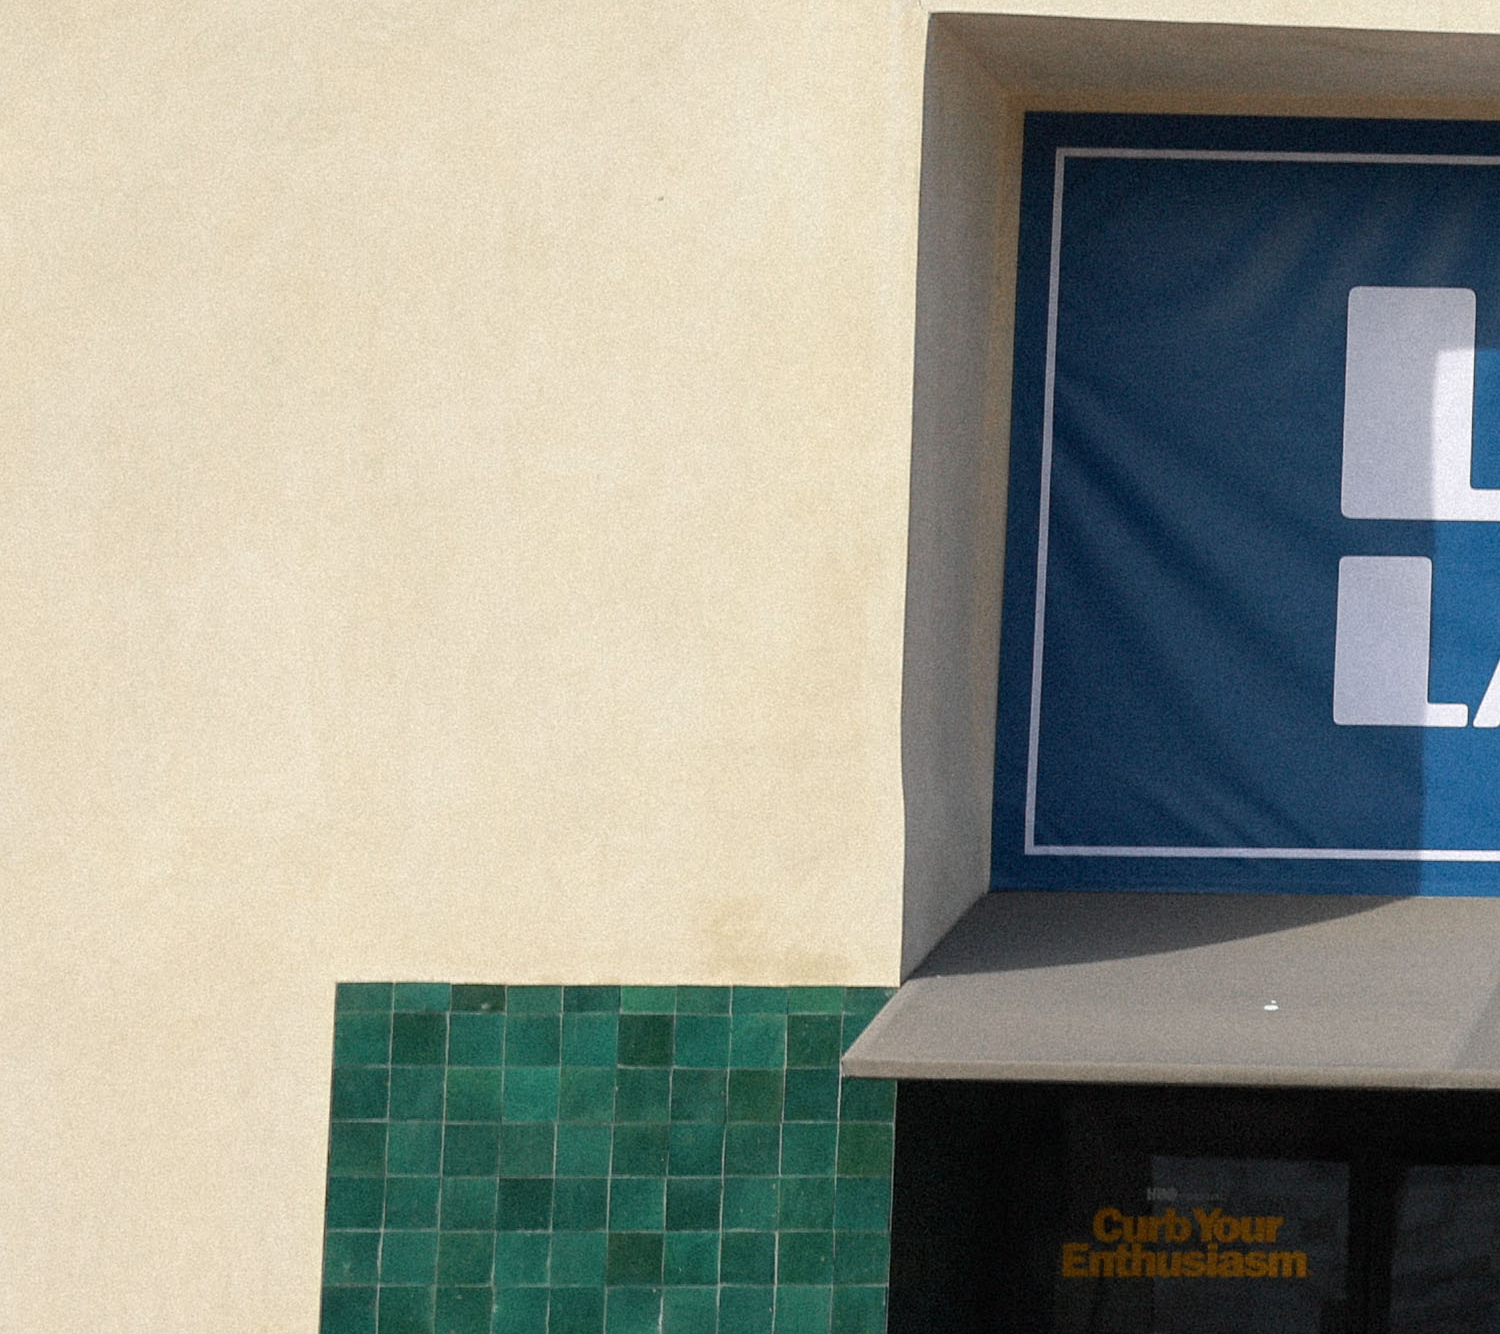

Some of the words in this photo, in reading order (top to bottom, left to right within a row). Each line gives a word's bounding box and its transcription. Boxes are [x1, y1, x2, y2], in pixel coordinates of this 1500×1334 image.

[1093, 1207, 1192, 1243] Curb
[1191, 1208, 1284, 1243] Your
[1062, 1242, 1308, 1278] Enthusiasm
